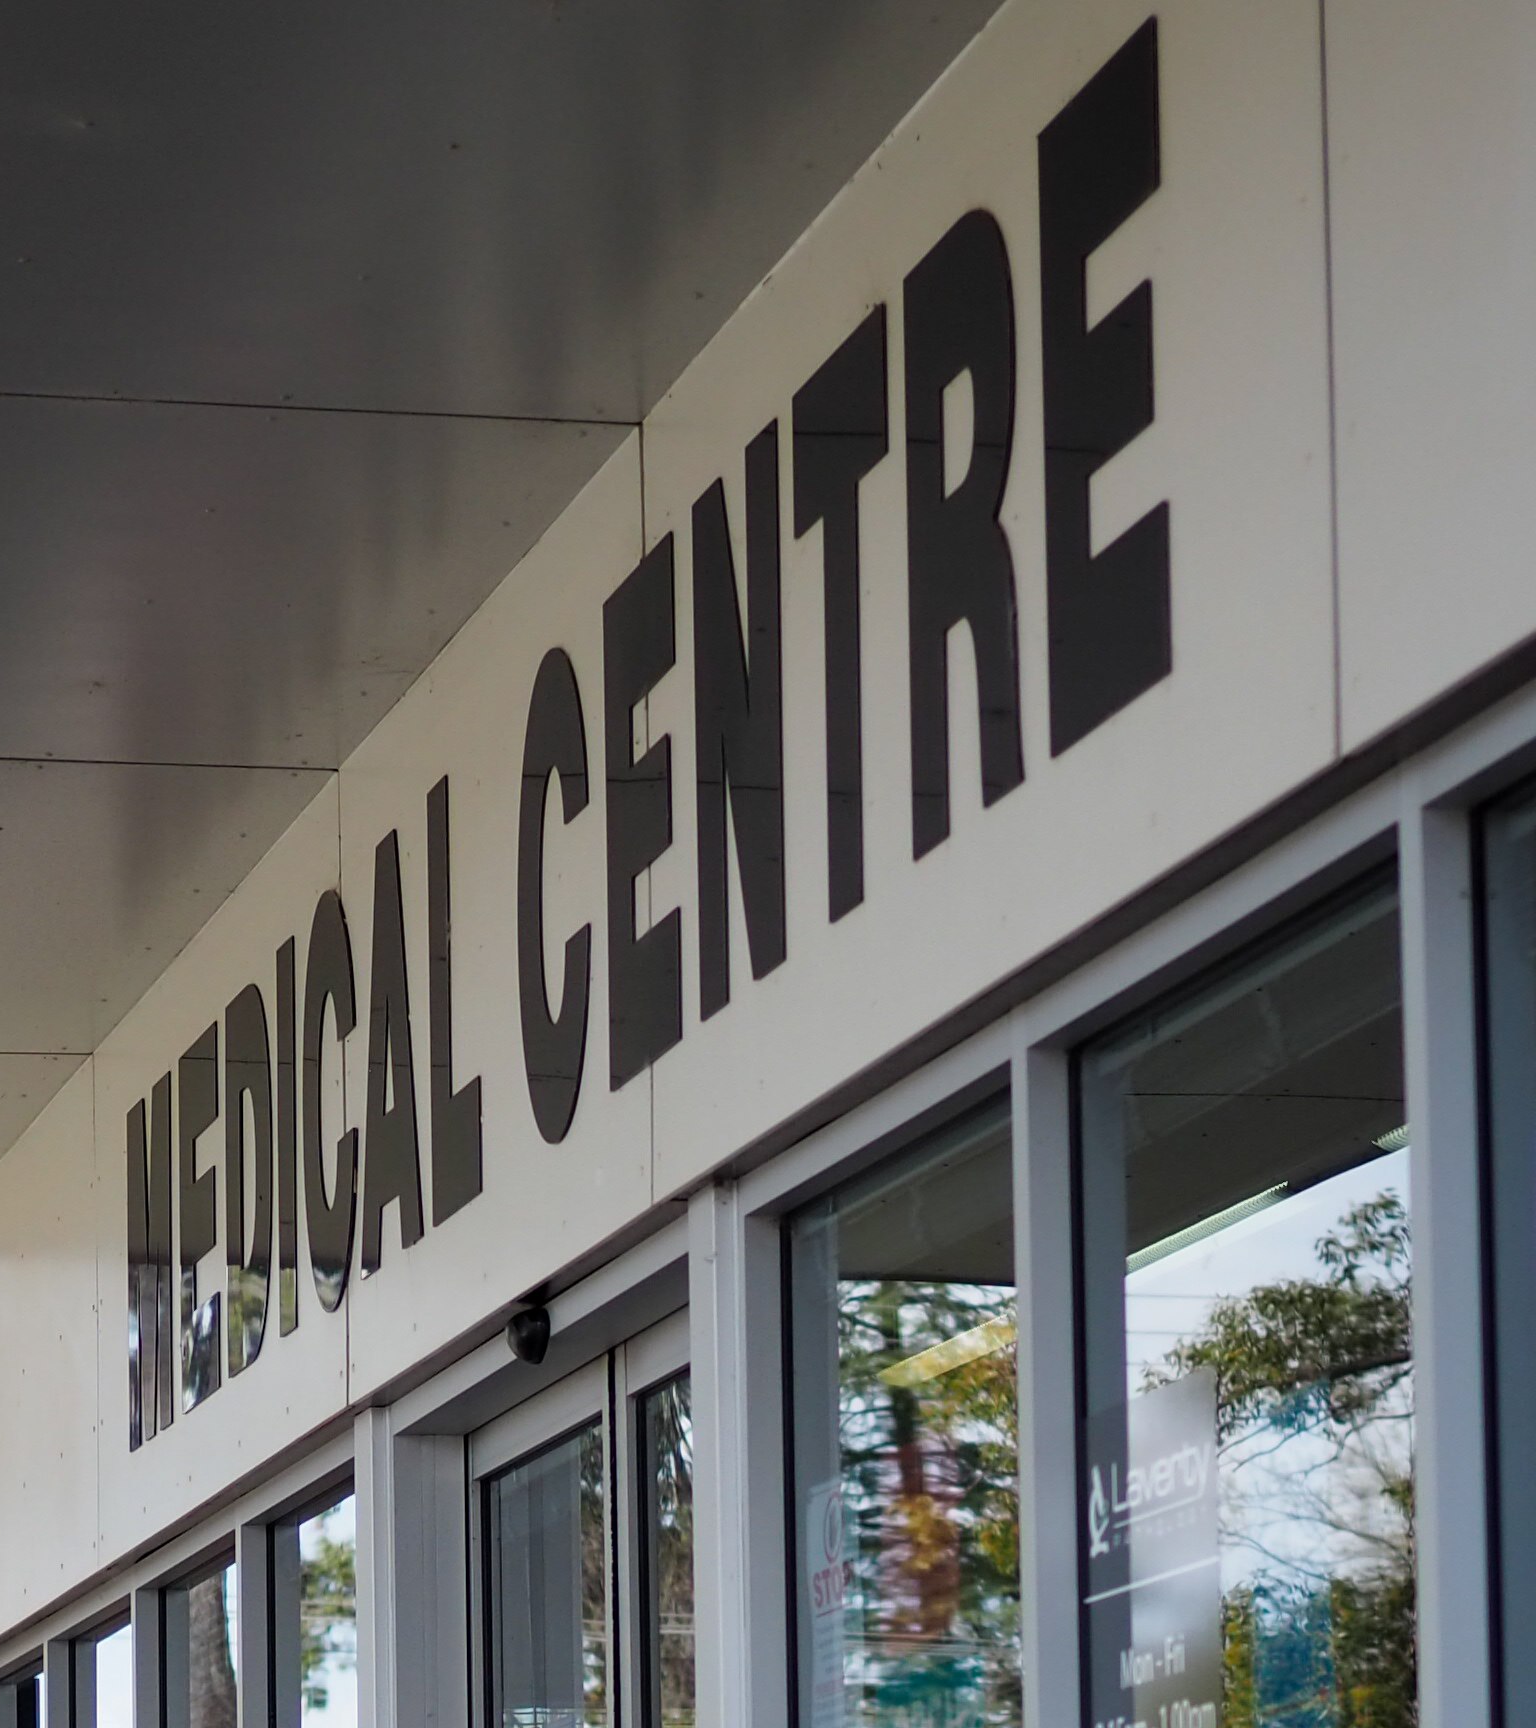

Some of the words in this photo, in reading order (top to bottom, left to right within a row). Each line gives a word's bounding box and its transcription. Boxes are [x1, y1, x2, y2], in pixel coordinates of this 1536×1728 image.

[126, 774, 483, 1452] MEDICAL
[517, 14, 1173, 1144] CENTRE
[1120, 1648, 1153, 1690] Mon
